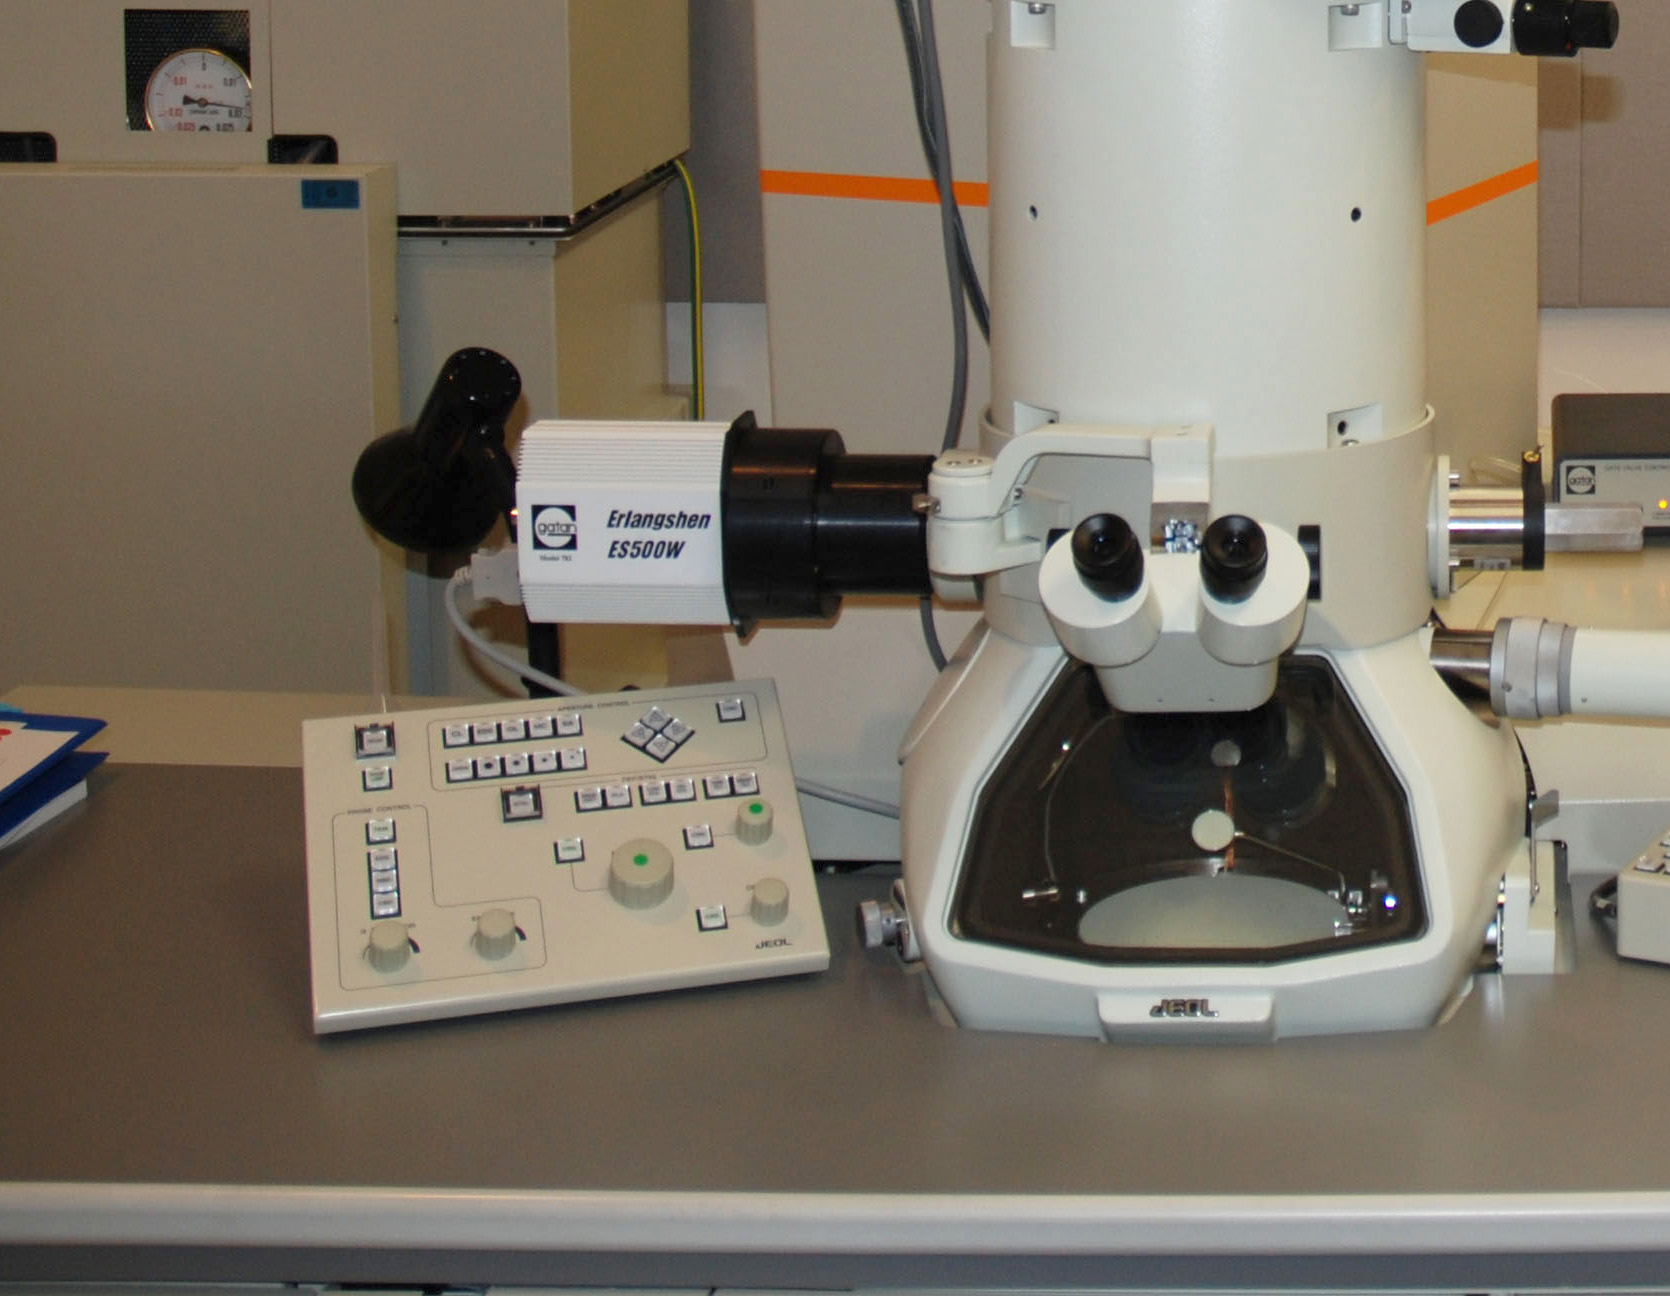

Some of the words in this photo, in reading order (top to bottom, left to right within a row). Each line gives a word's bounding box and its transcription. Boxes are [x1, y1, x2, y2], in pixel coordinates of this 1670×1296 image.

[537, 522, 578, 536] gatan
[606, 510, 711, 531] Erlangshen
[607, 540, 686, 559] ES500W
[755, 938, 793, 950] JEOL
[1150, 999, 1219, 1017] JEOL
